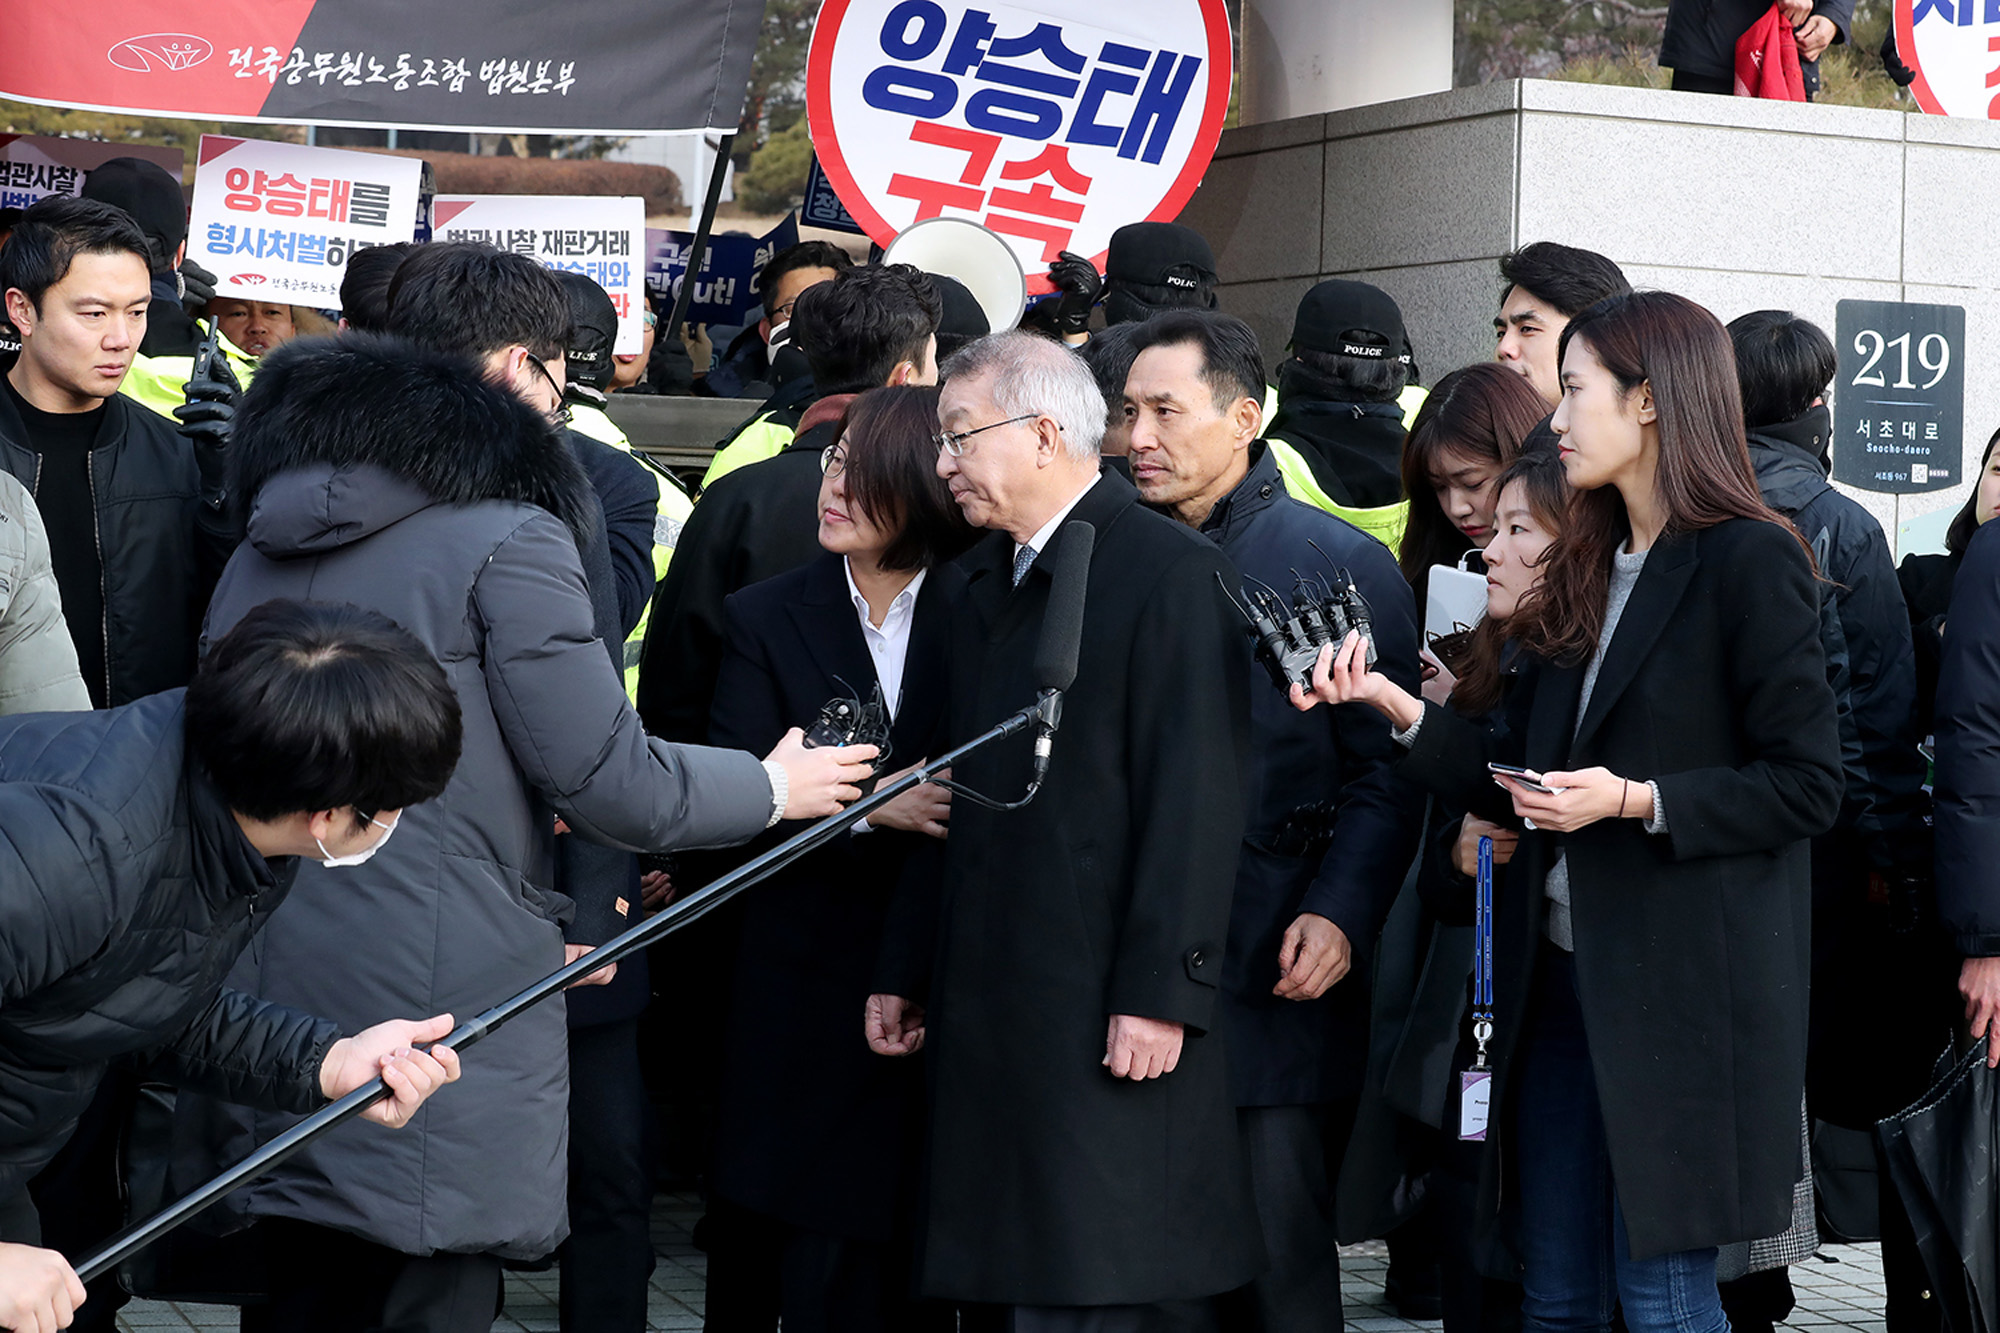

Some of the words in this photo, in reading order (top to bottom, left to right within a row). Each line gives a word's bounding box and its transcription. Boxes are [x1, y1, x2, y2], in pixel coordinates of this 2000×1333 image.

[228, 45, 471, 92] 전국공무원노동조합
[478, 57, 576, 96] 법원본부
[862, 0, 1202, 165] 양승태
[224, 167, 391, 228] 양승태를
[887, 119, 1092, 263] 구속
[206, 222, 385, 266] 형사처벌하
[541, 229, 630, 256] 재판거래
[271, 277, 338, 296] 전국공무원노동
[546, 260, 631, 287] 태와
[1167, 275, 1197, 289] POLIC
[568, 350, 598, 362] LICE
[1344, 344, 1382, 356] POLICE
[1852, 330, 1950, 390] 219
[1856, 419, 1940, 441] 서초대로
[1866, 443, 1931, 455] Seocho-daero
[1894, 472, 1908, 482] 967
